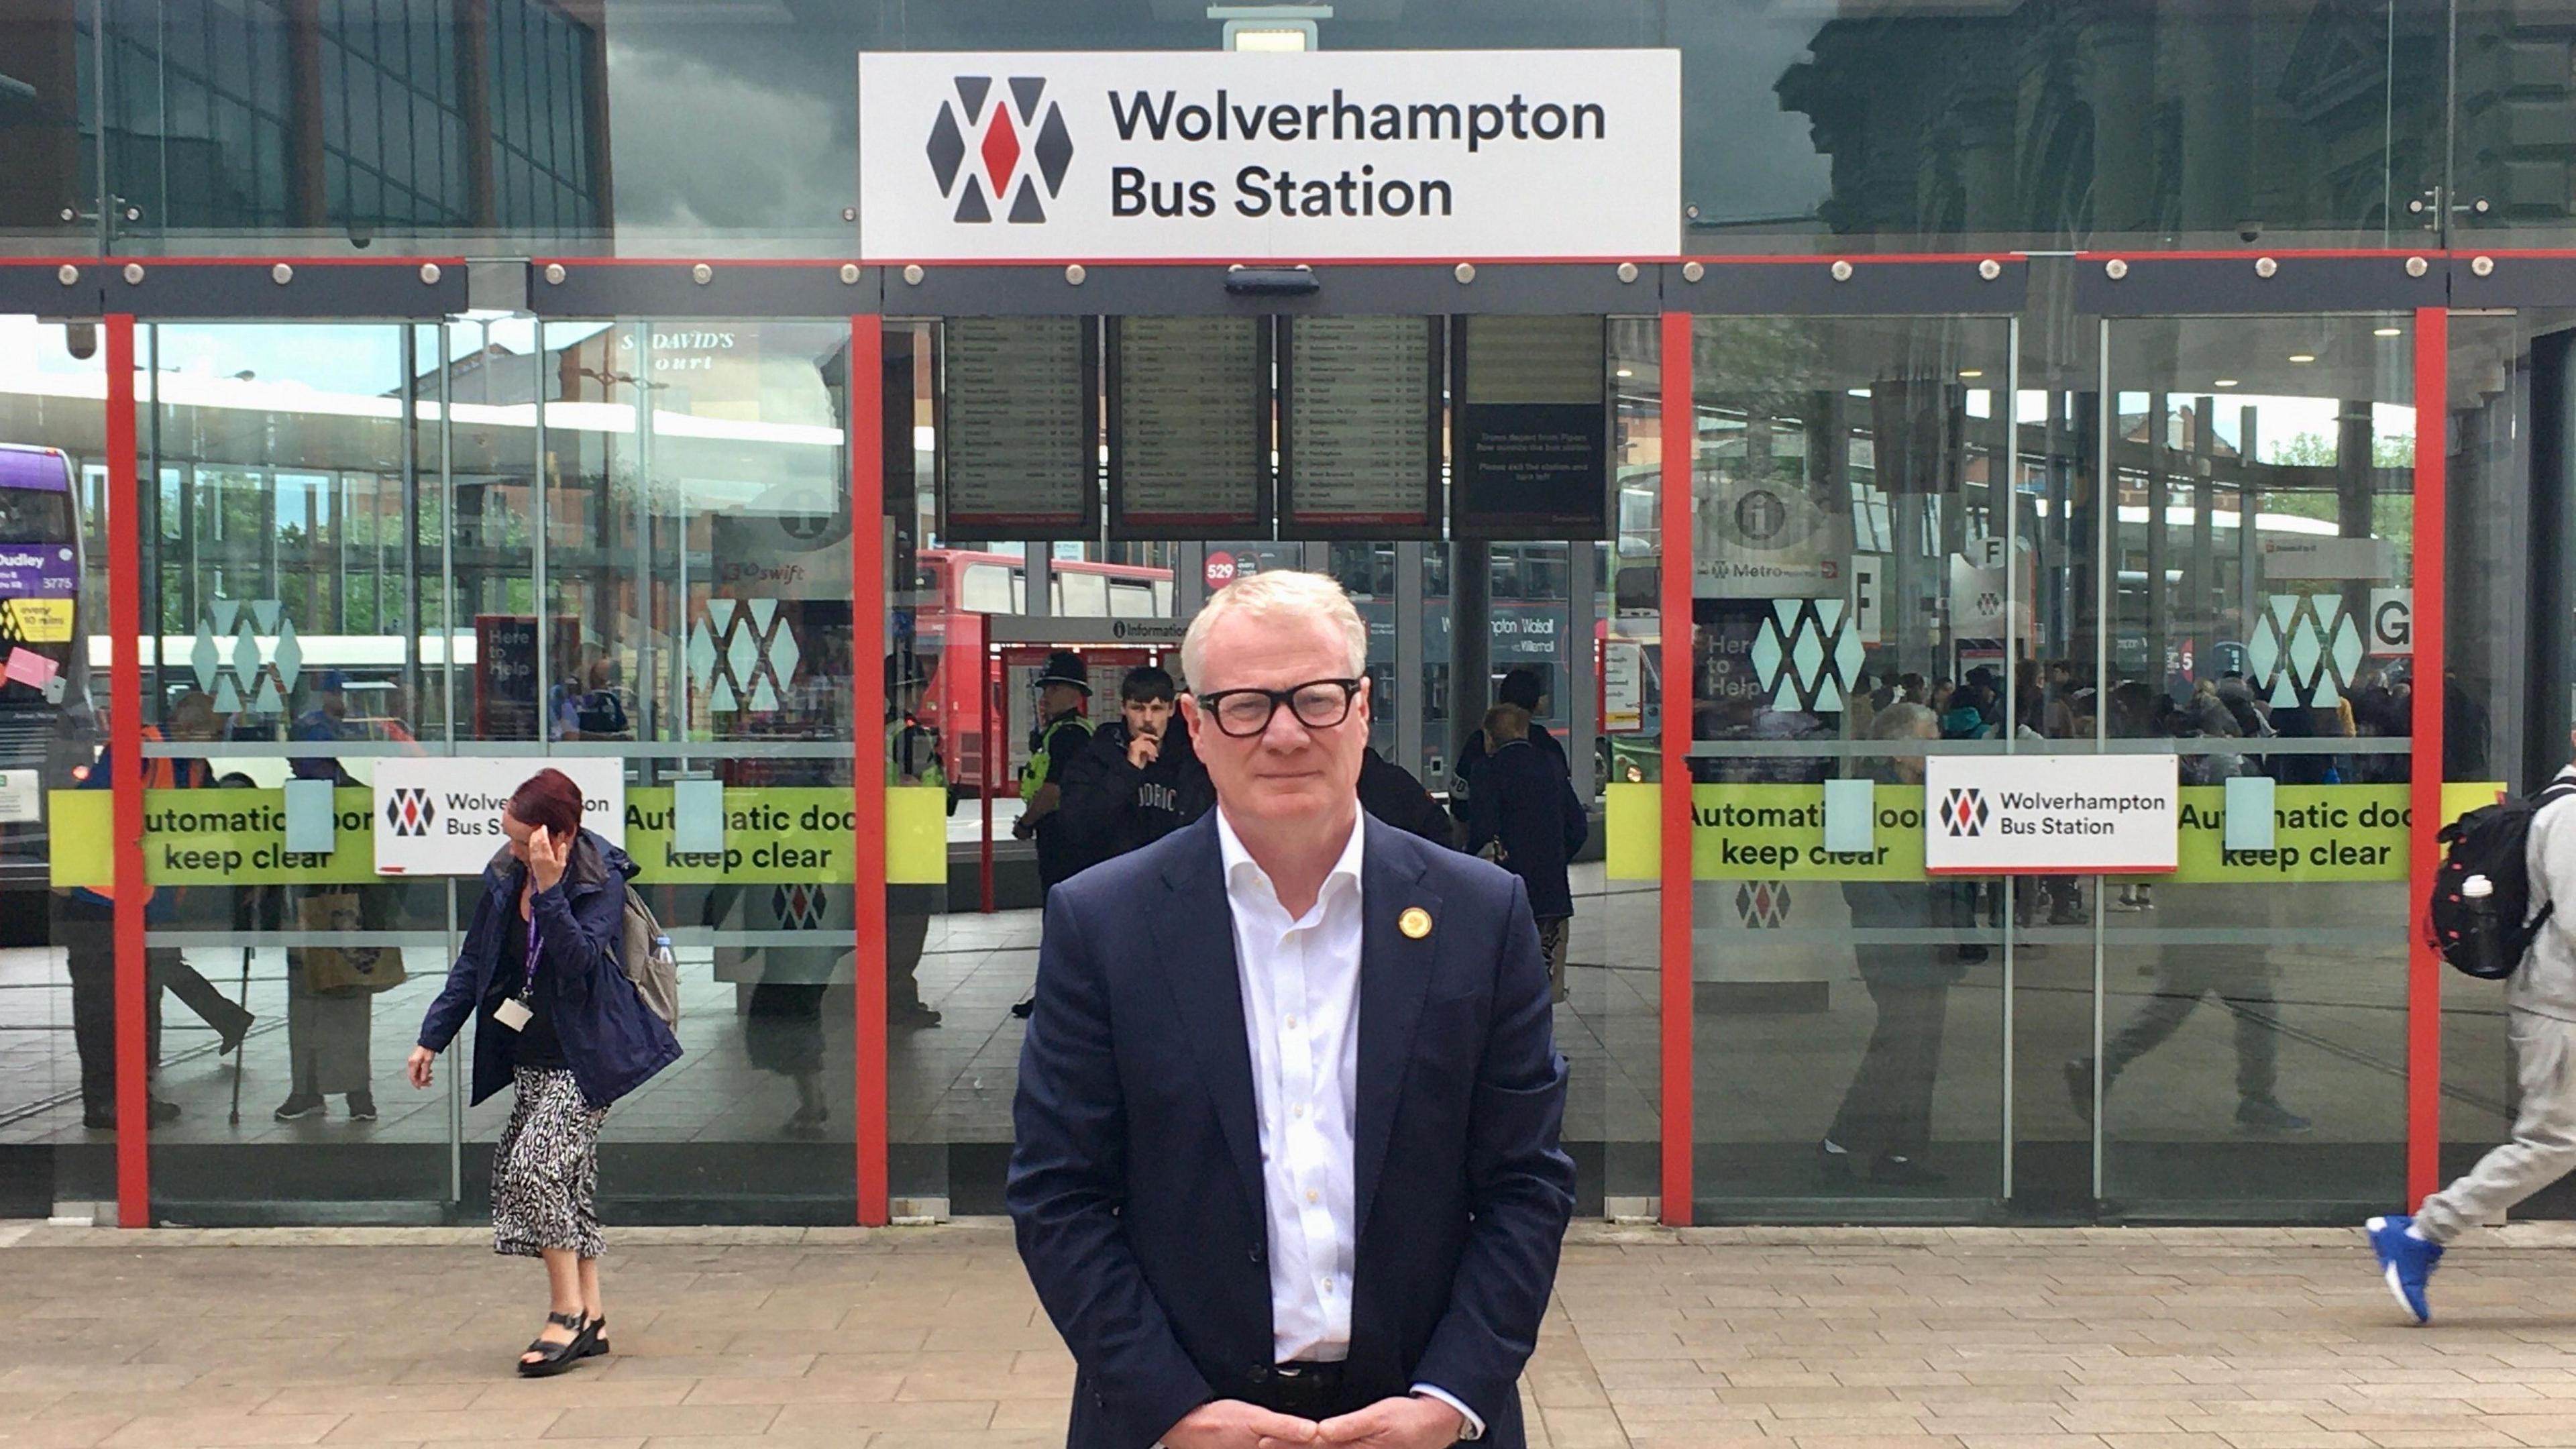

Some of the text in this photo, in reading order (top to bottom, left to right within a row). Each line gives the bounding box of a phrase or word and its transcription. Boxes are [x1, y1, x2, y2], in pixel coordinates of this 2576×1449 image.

[1108, 89, 1605, 153] Wolverhampton
[1111, 164, 1452, 218] Bus Station
[655, 356, 712, 370] ourt
[1986, 541, 2000, 564] F
[759, 564, 805, 585] swift
[1207, 564, 1234, 579] 529
[1733, 563, 1782, 578] Metro
[1856, 572, 1871, 631] F
[2375, 600, 2410, 645] G
[489, 629, 530, 644] Here
[489, 661, 530, 677] Help
[1707, 657, 1730, 674] to
[1708, 676, 1761, 700] Help
[446, 793, 610, 812] Wolveon
[1691, 800, 1825, 828] utomati
[2000, 792, 2165, 814] Wolverhampton
[145, 804, 374, 833] utomatic or
[447, 818, 482, 835] Bus
[625, 804, 857, 832] Autatic doo
[2000, 817, 2114, 835] Bus Station
[2178, 801, 2411, 829] Auatic doo
[165, 842, 333, 875] keep clear
[665, 841, 833, 874] keep clear
[1722, 838, 1799, 871] keep
[2221, 839, 2391, 872] keep clear
